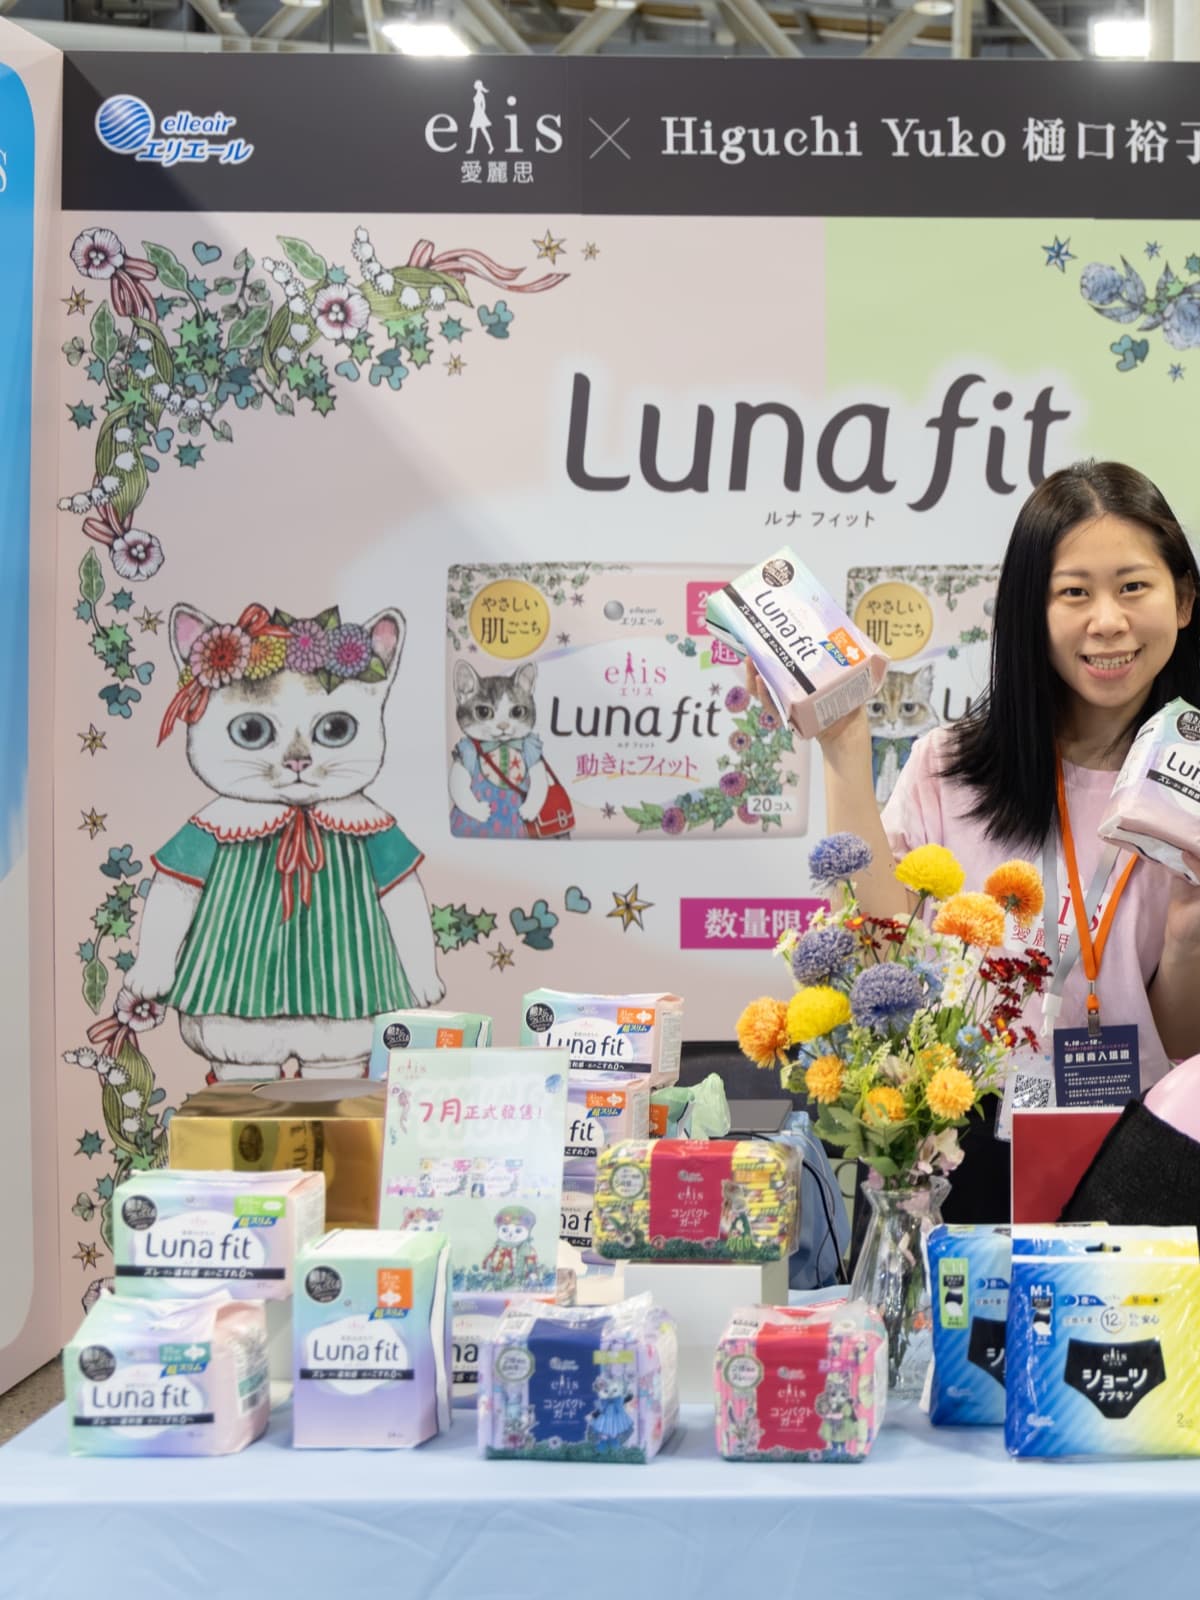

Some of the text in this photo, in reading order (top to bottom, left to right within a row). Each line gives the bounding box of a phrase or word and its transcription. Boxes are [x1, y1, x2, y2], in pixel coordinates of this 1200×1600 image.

[162, 112, 236, 137] elleair
[661, 114, 863, 164] Higuchi
[881, 116, 1006, 158] Yuko
[138, 139, 253, 165] エリエール
[460, 160, 534, 184] 愛麗思
[481, 597, 539, 613] やさしい
[866, 600, 922, 615] やさしい
[481, 617, 542, 645] 肌ごこち
[866, 619, 925, 646] 肌ごこち
[576, 753, 698, 778] 動きにフィット
[704, 907, 830, 940] 数量限
[600, 1033, 624, 1057] fit
[145, 1233, 252, 1261] Luna fit
[313, 1339, 400, 1362] Luna fit
[1082, 1369, 1148, 1389] ショーツ
[92, 1383, 192, 1410] Luna fit
[1098, 1391, 1133, 1401] ナプキン
